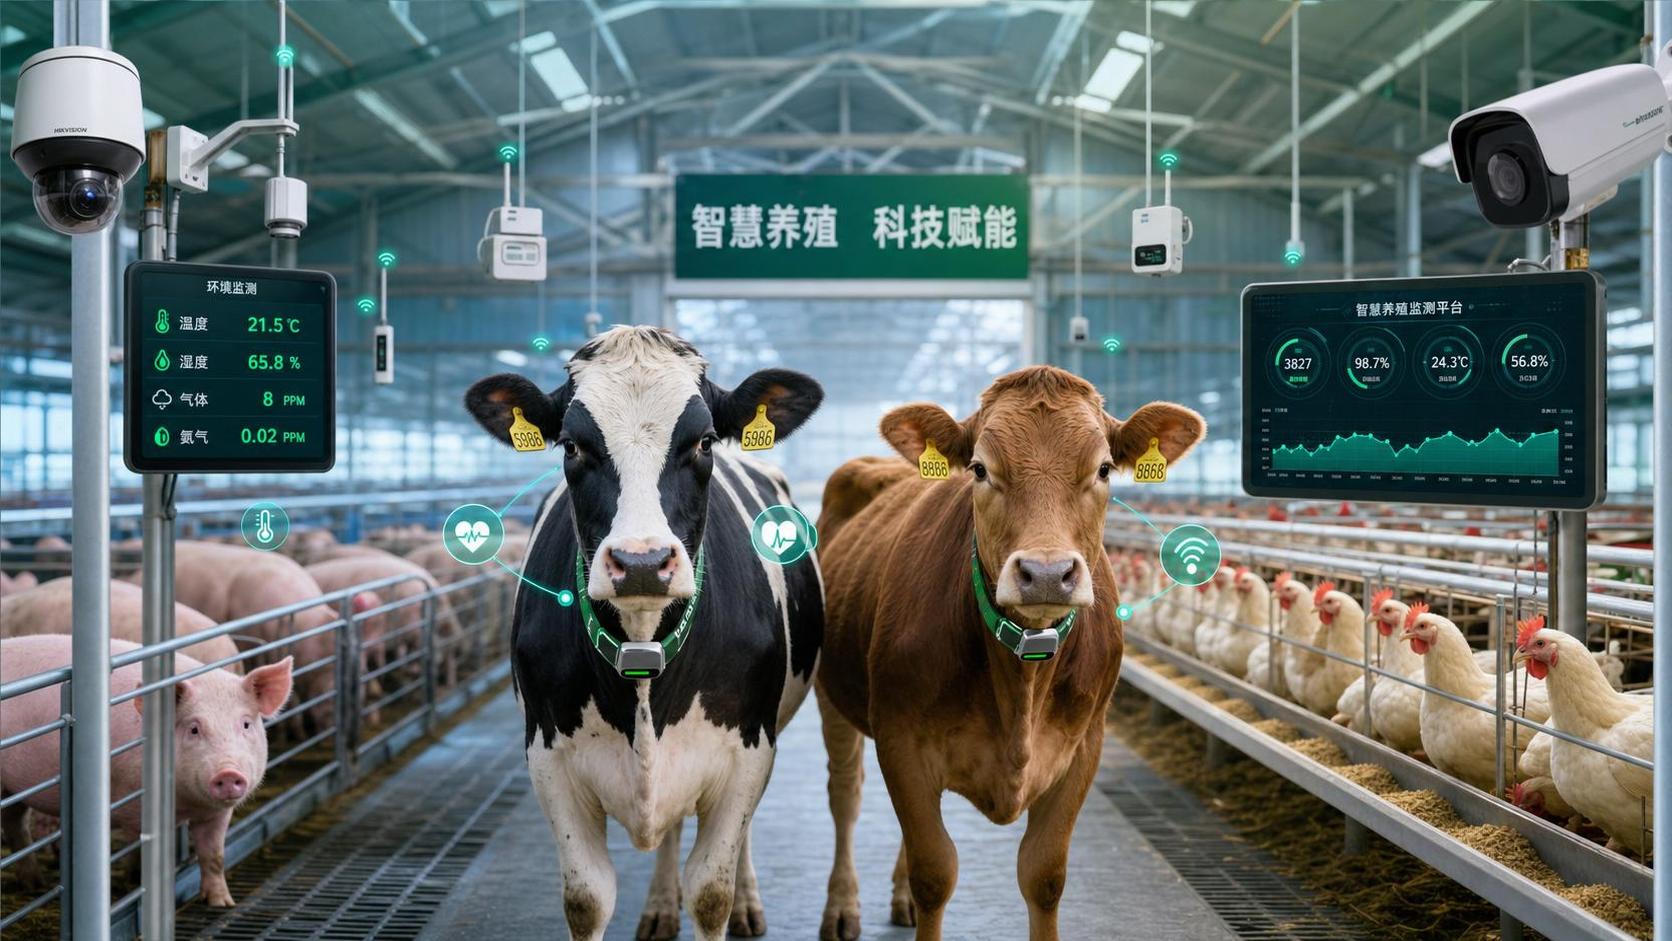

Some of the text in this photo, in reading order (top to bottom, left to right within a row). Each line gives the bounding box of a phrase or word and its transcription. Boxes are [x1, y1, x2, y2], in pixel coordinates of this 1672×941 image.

[691, 203, 1018, 249] 智慧养殖 科技赋能
[206, 280, 257, 295] 环境监测
[1356, 300, 1463, 317] 智慧养殖监测平台
[247, 317, 284, 333] 21.5
[179, 354, 301, 370] 湿度 65.8 %
[1284, 357, 1312, 370] 3827
[1354, 357, 1390, 369] 98.7%
[1511, 354, 1549, 368] 56.8%
[179, 391, 306, 408] 气体 8 PPM
[240, 428, 278, 444] 0.02
[283, 431, 306, 443] PPM
[744, 430, 773, 447] 5986
